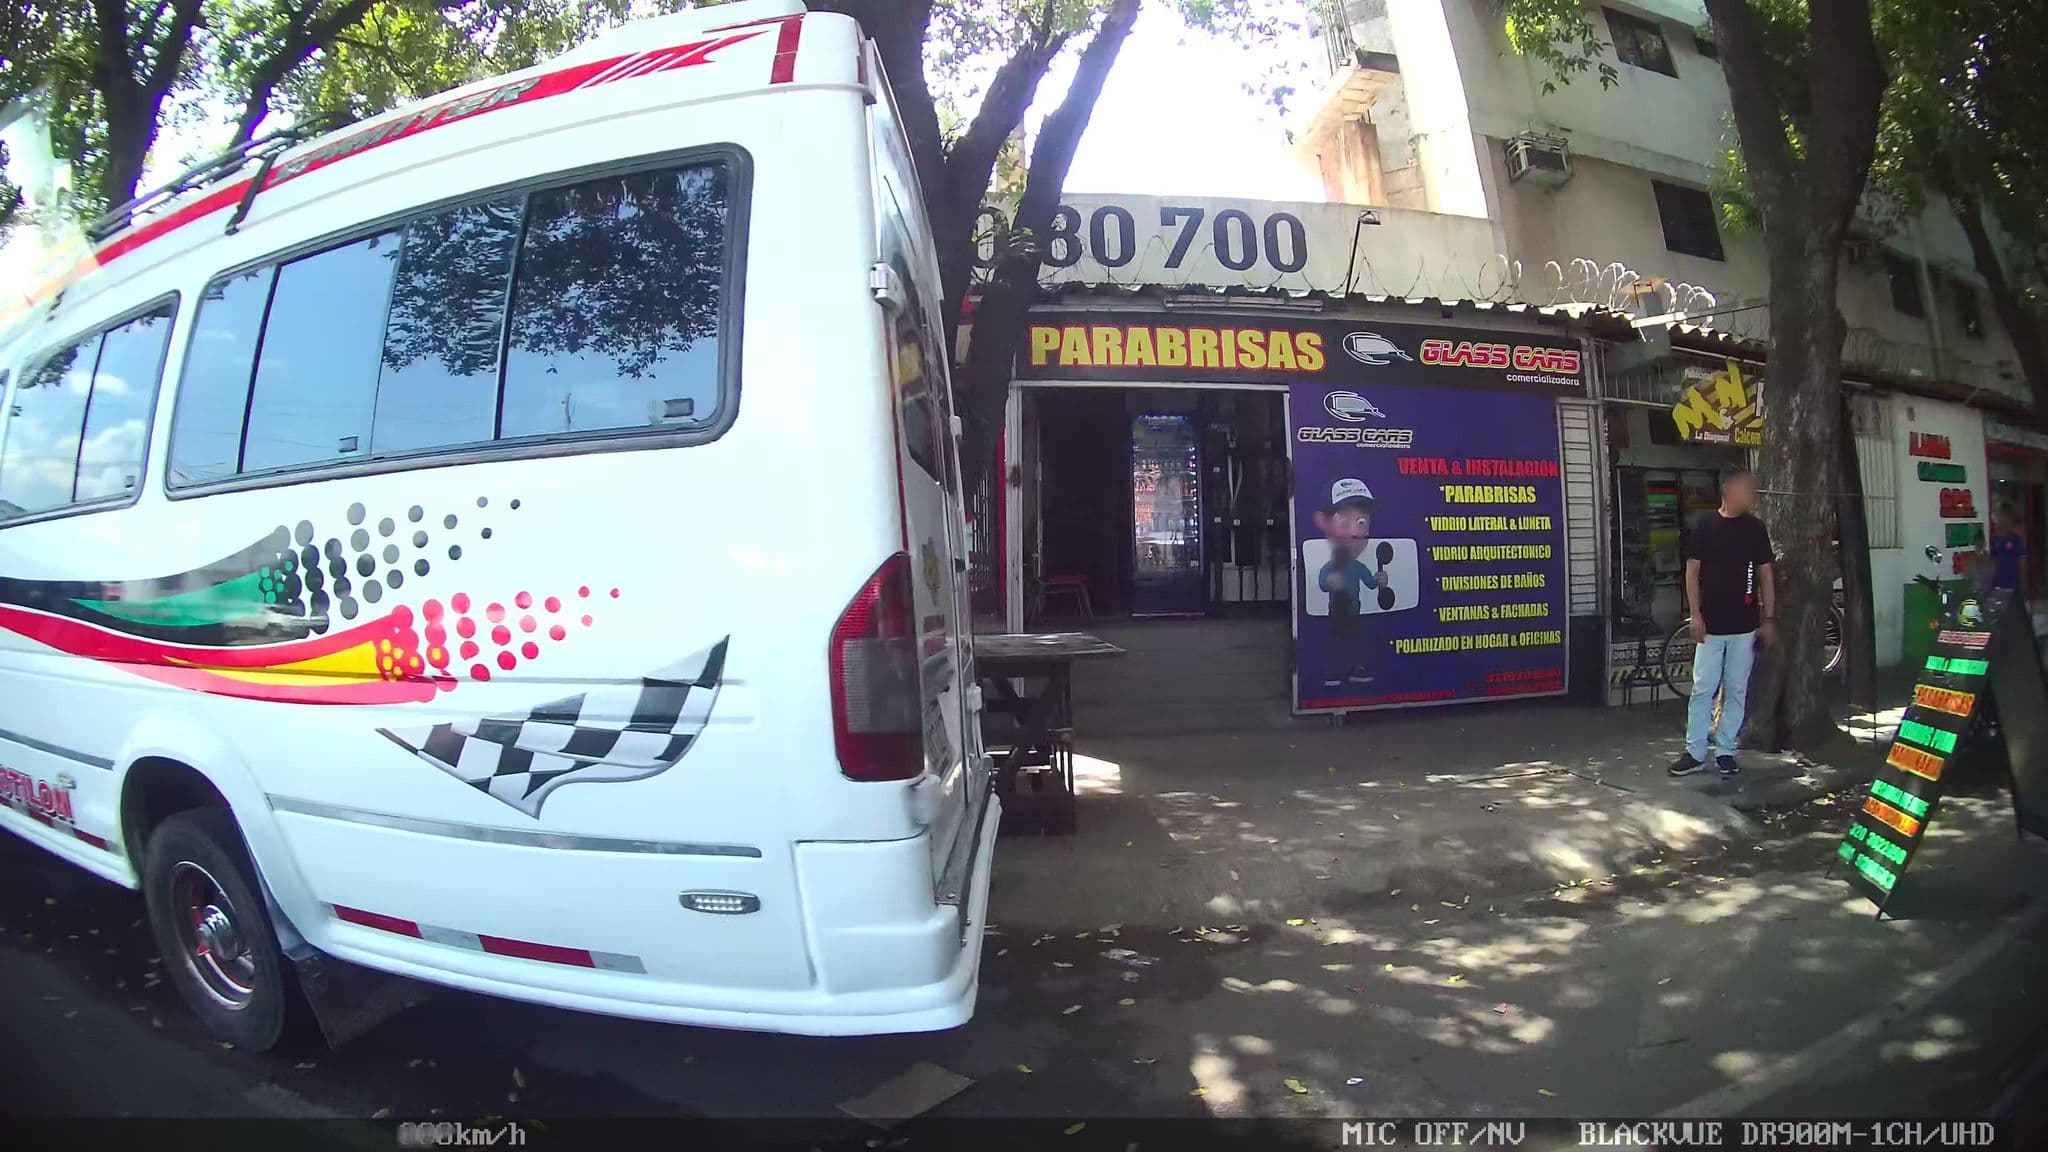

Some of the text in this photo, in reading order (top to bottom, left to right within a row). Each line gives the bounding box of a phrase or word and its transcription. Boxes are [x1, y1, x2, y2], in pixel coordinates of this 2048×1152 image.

[1160, 207, 1308, 273] 700
[1031, 326, 1325, 371] PARABRISAS
[1420, 339, 1580, 374] GLASS CARS
[1506, 373, 1579, 386] comercializadora
[1298, 427, 1413, 444] GLASS CARS
[1398, 457, 1448, 475] VENTA
[1430, 517, 1465, 531] VIDRIO
[1469, 517, 1508, 531] LATERAL
[1519, 516, 1552, 530] LUNETA
[1432, 546, 1468, 561] VIDRIO
[1441, 571, 1545, 591] DIVISIONES DE BAÑOS
[1439, 605, 1490, 622] VENTANAS
[1501, 603, 1549, 619] FACHADAS
[1395, 636, 1459, 654] POLARIZADO
[1461, 636, 1473, 650] EN
[1475, 633, 1509, 649] HOGAR
[1519, 630, 1561, 646] OFICINAS
